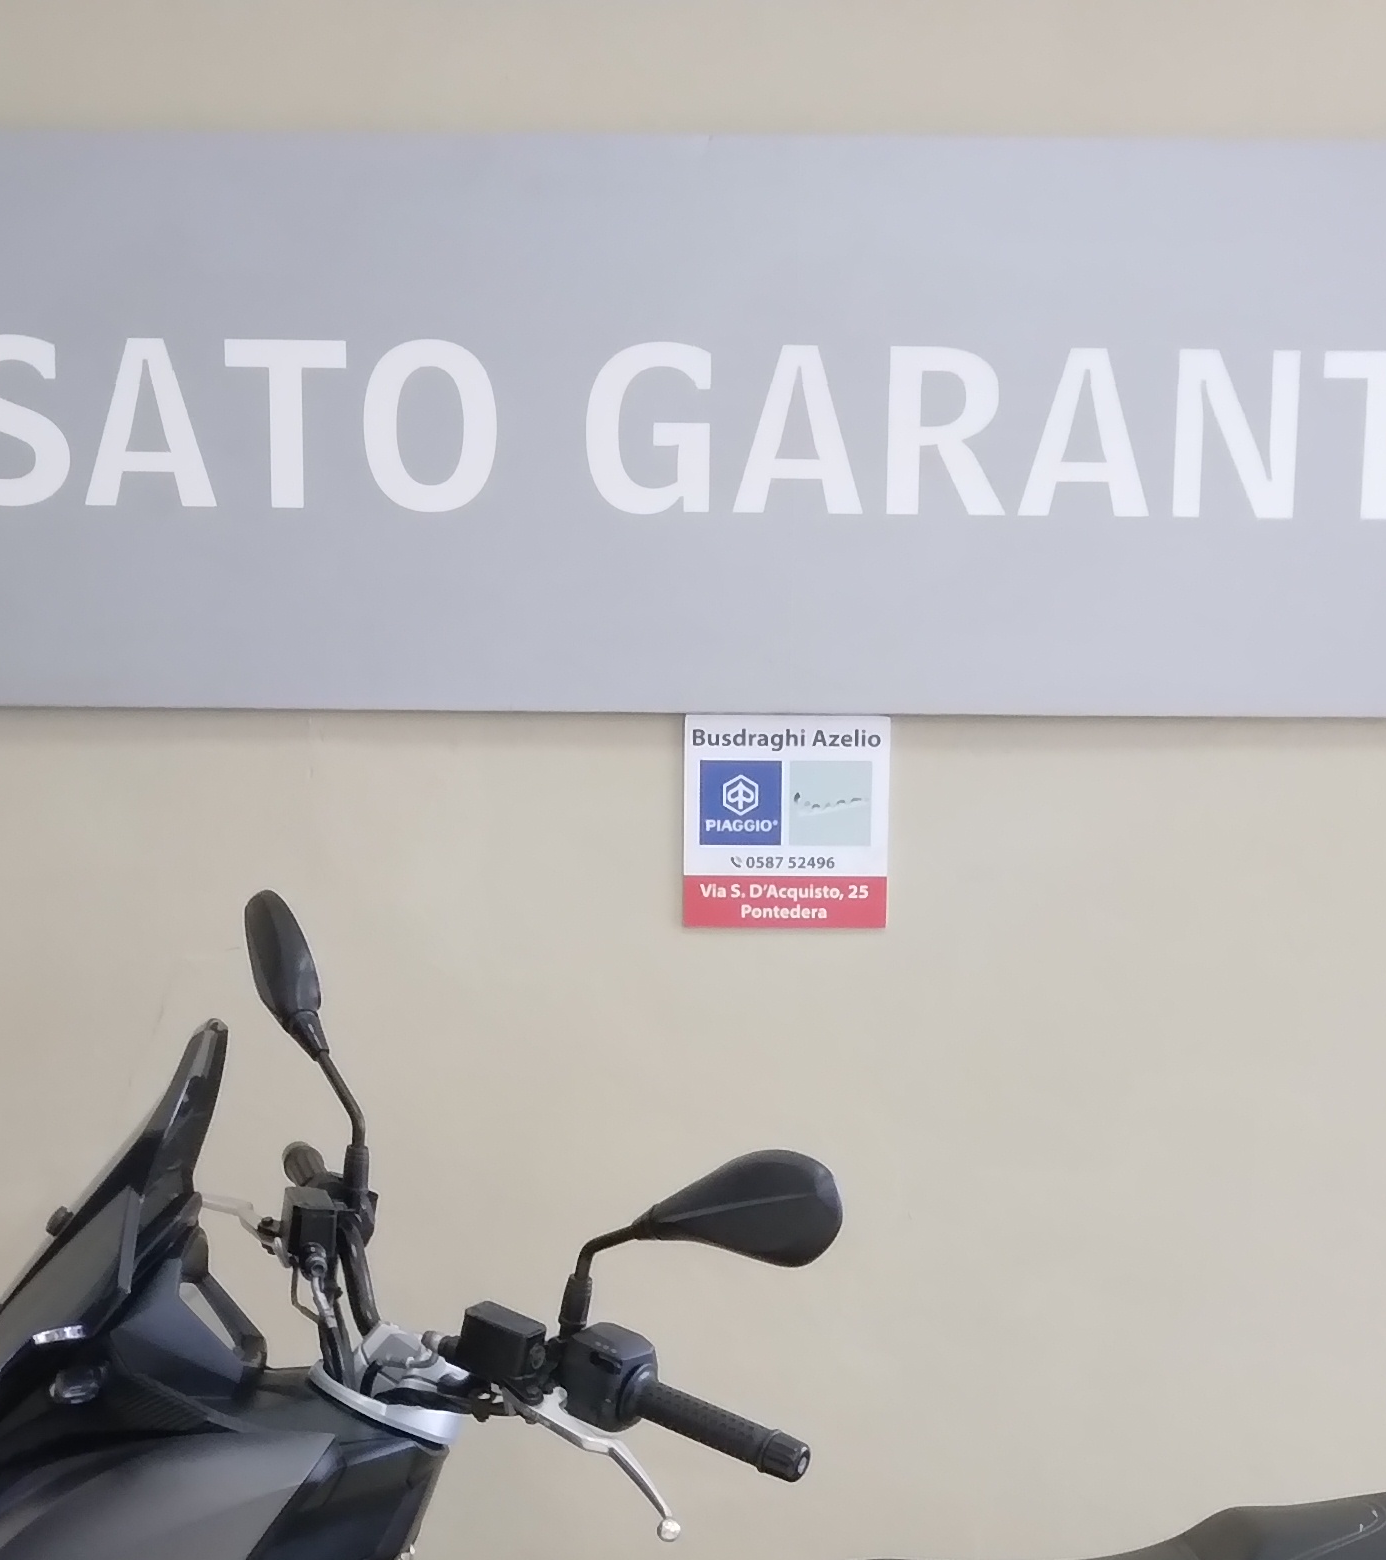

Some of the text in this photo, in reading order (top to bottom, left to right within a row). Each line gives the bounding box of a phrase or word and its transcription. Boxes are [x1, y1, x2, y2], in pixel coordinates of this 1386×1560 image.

[692, 728, 882, 752] Busdraghi Azelio
[705, 819, 773, 833] PIAGGIO
[745, 856, 835, 870] 0587 52496
[699, 883, 727, 899] Via
[730, 883, 746, 899] S.
[847, 884, 869, 899] 25
[740, 904, 828, 919] Pontedera
